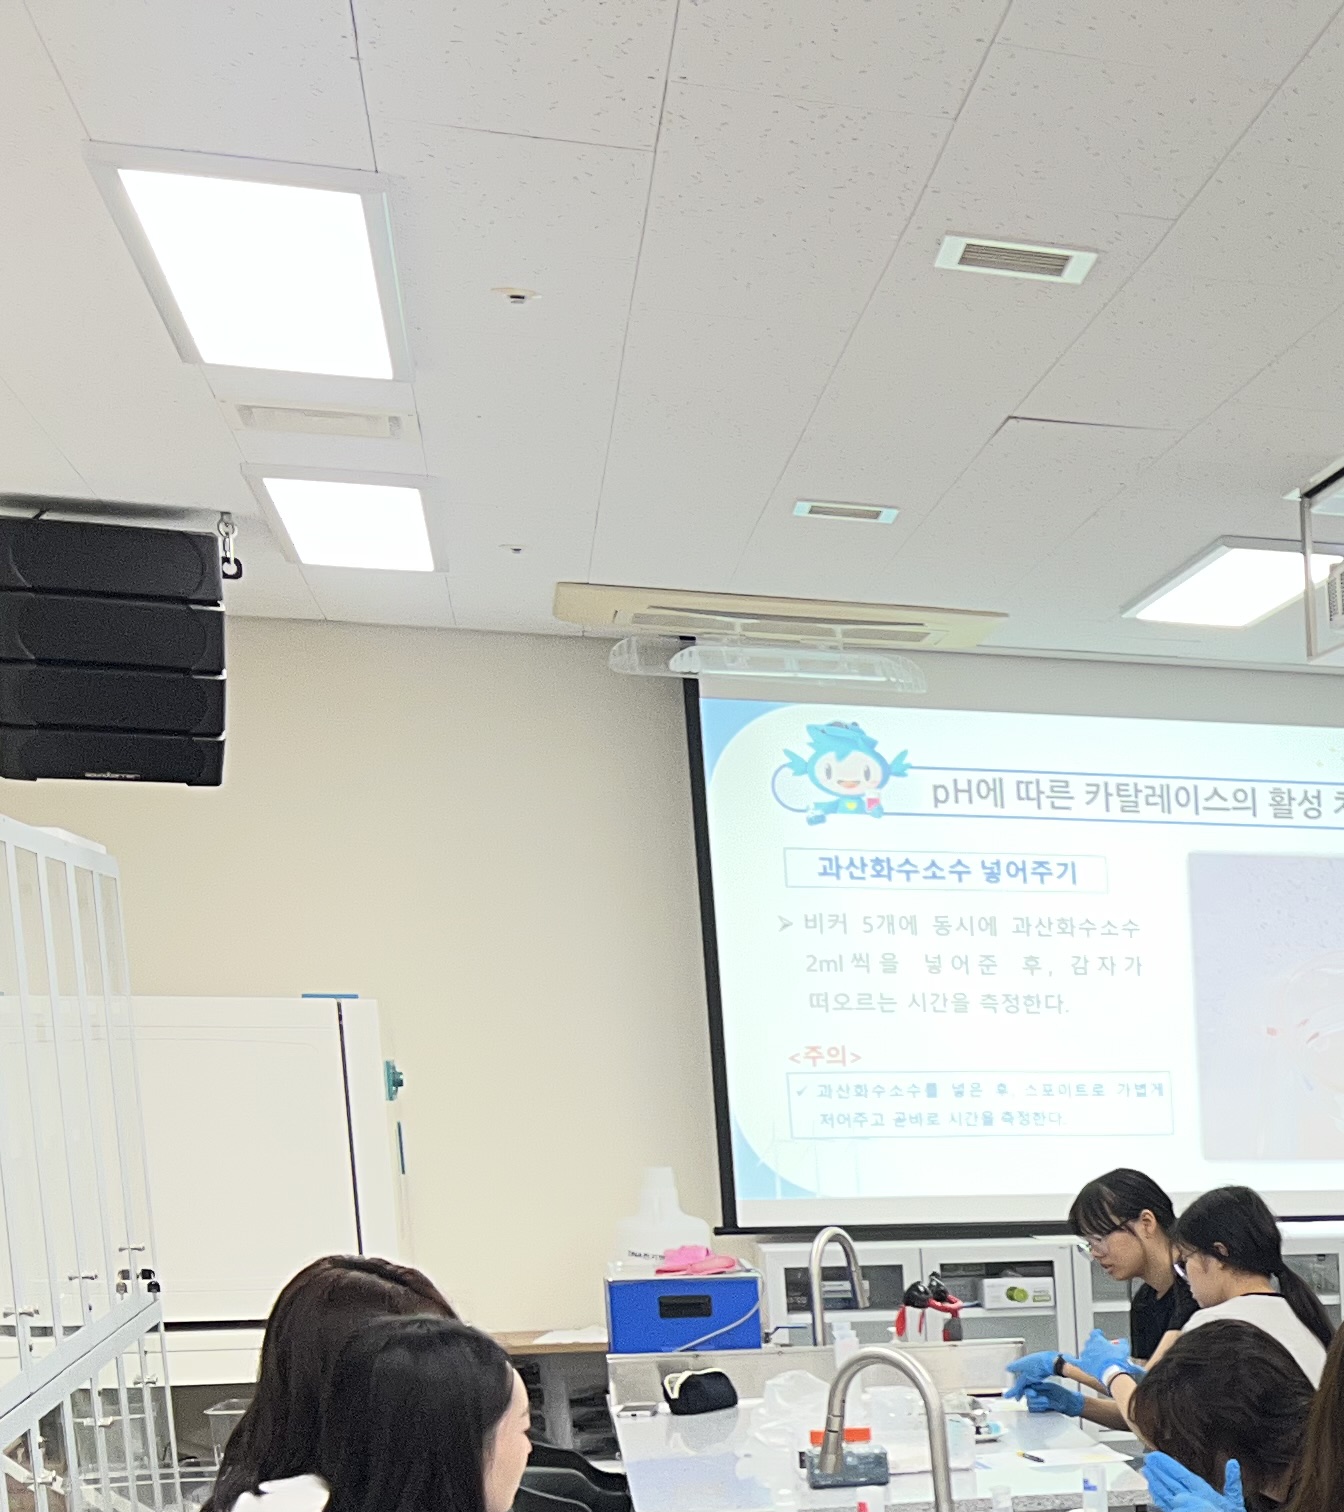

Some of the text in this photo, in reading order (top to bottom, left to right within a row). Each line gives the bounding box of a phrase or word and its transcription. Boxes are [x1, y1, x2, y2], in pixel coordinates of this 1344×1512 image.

[932, 777, 1005, 809] pH에
[1016, 778, 1075, 811] 따른
[1085, 781, 1257, 818] 카탈레이스의
[1268, 787, 1323, 820] 활성
[817, 855, 1078, 886] 과산화수소수 넣어주기
[804, 912, 1141, 939] 비커 5개에 동시에 과산화수소수
[924, 953, 998, 976] 넣어준
[1022, 955, 1053, 977] 후,
[1071, 954, 1142, 977] 감자가
[808, 991, 1070, 1015] 떠오르는 시간을 측정한다.
[788, 1045, 862, 1067] <주의>
[820, 1112, 885, 1128] 저어주고
[892, 1111, 941, 1128] 곧바로
[949, 1111, 994, 1127] 시간을
